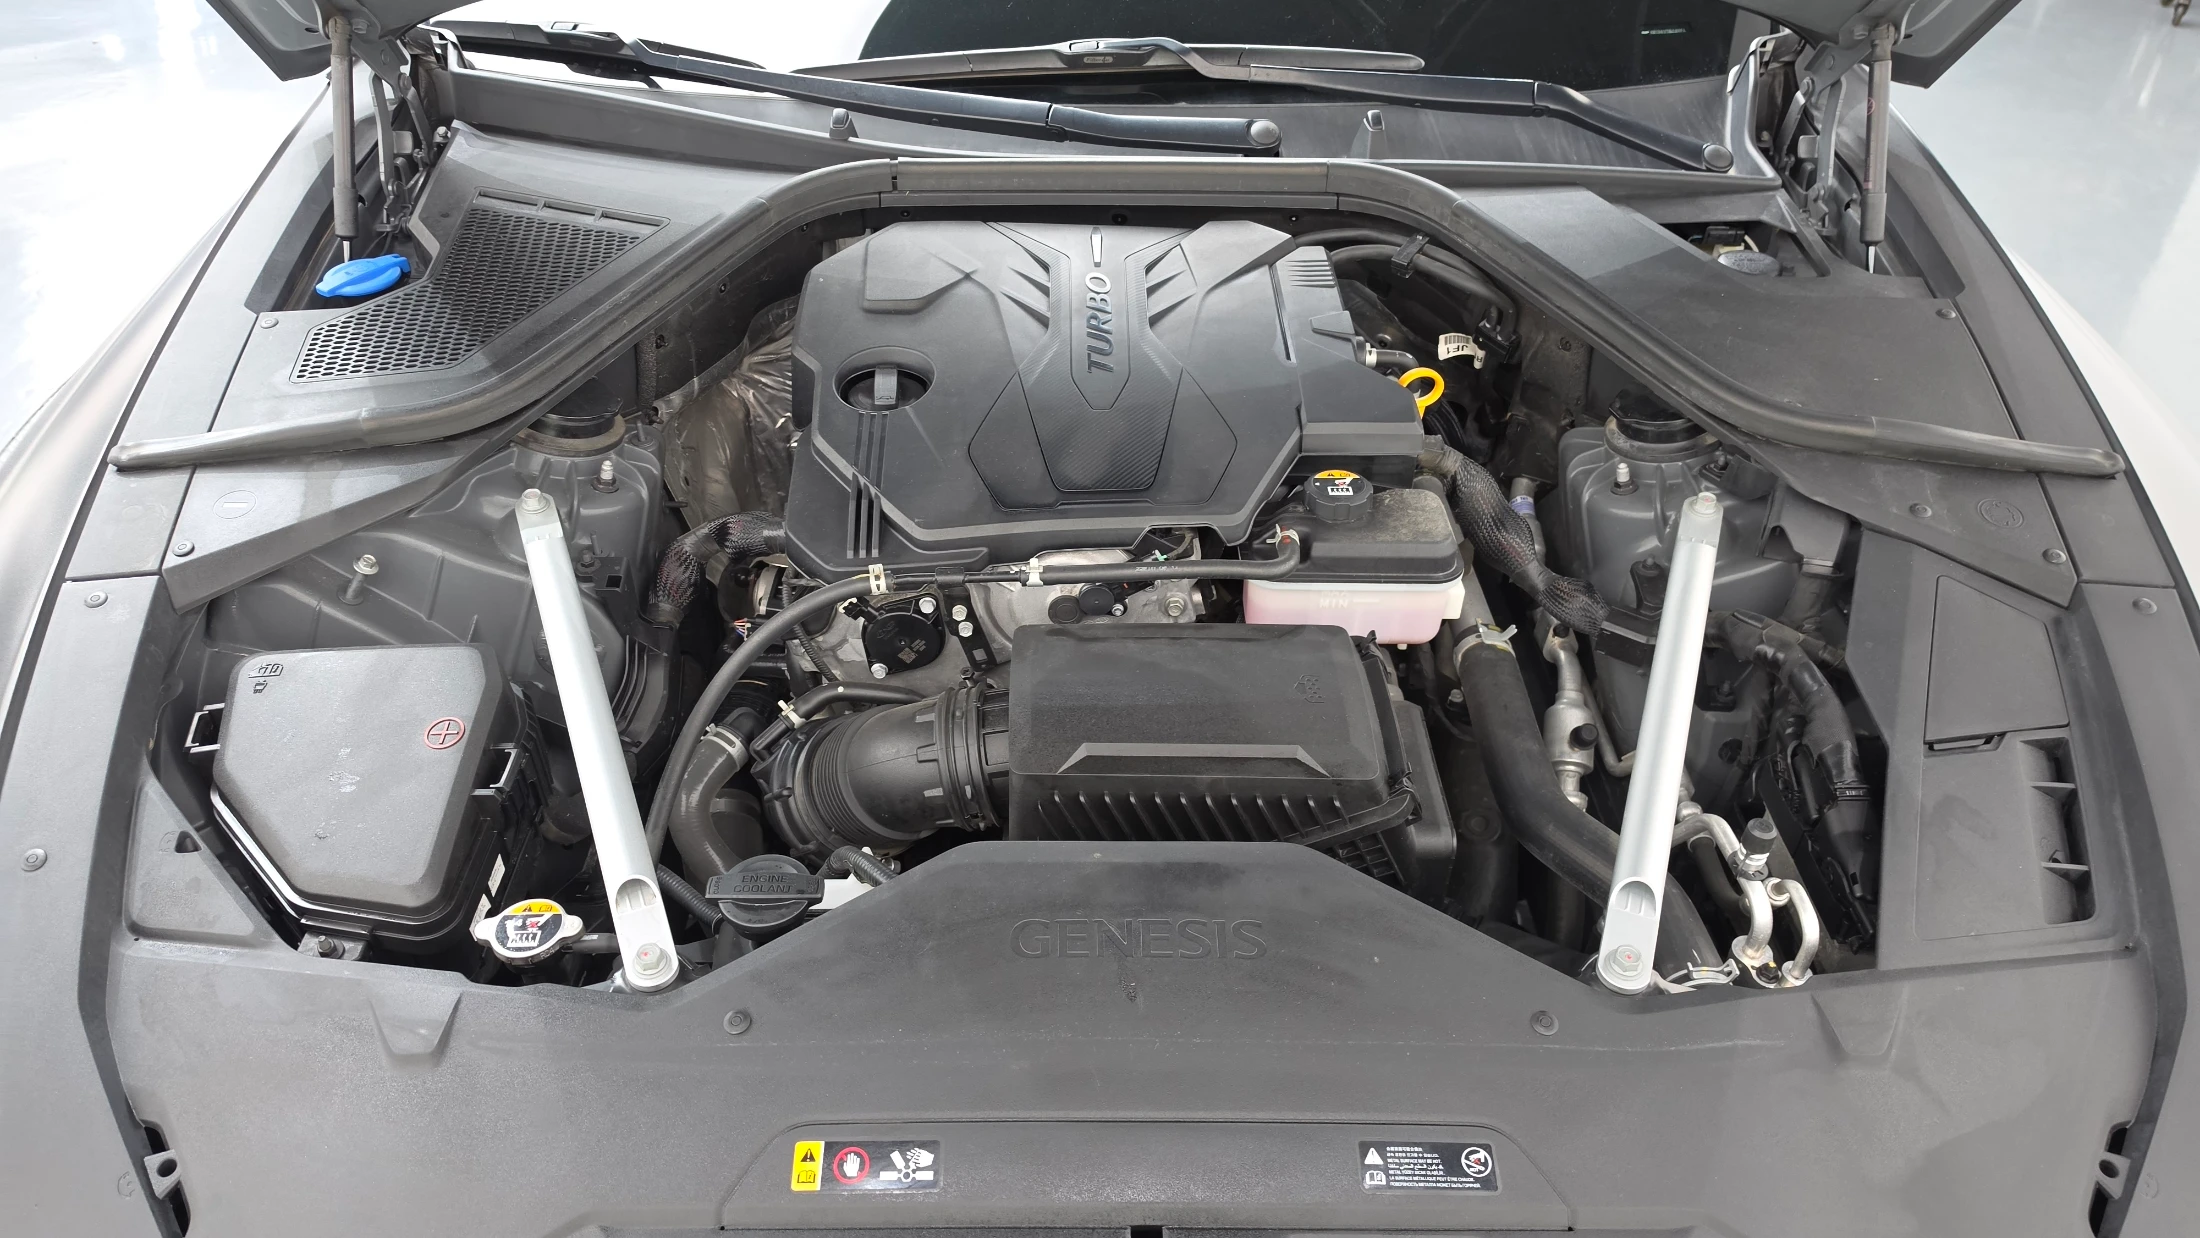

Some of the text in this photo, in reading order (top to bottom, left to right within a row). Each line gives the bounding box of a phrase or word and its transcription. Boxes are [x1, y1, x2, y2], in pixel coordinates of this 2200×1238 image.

[1085, 271, 1114, 373] TURBO
[1446, 344, 1469, 355] JF1
[742, 875, 788, 883] ENGINE
[733, 884, 792, 893] COOLANT
[1010, 918, 1268, 960] GENESIS
